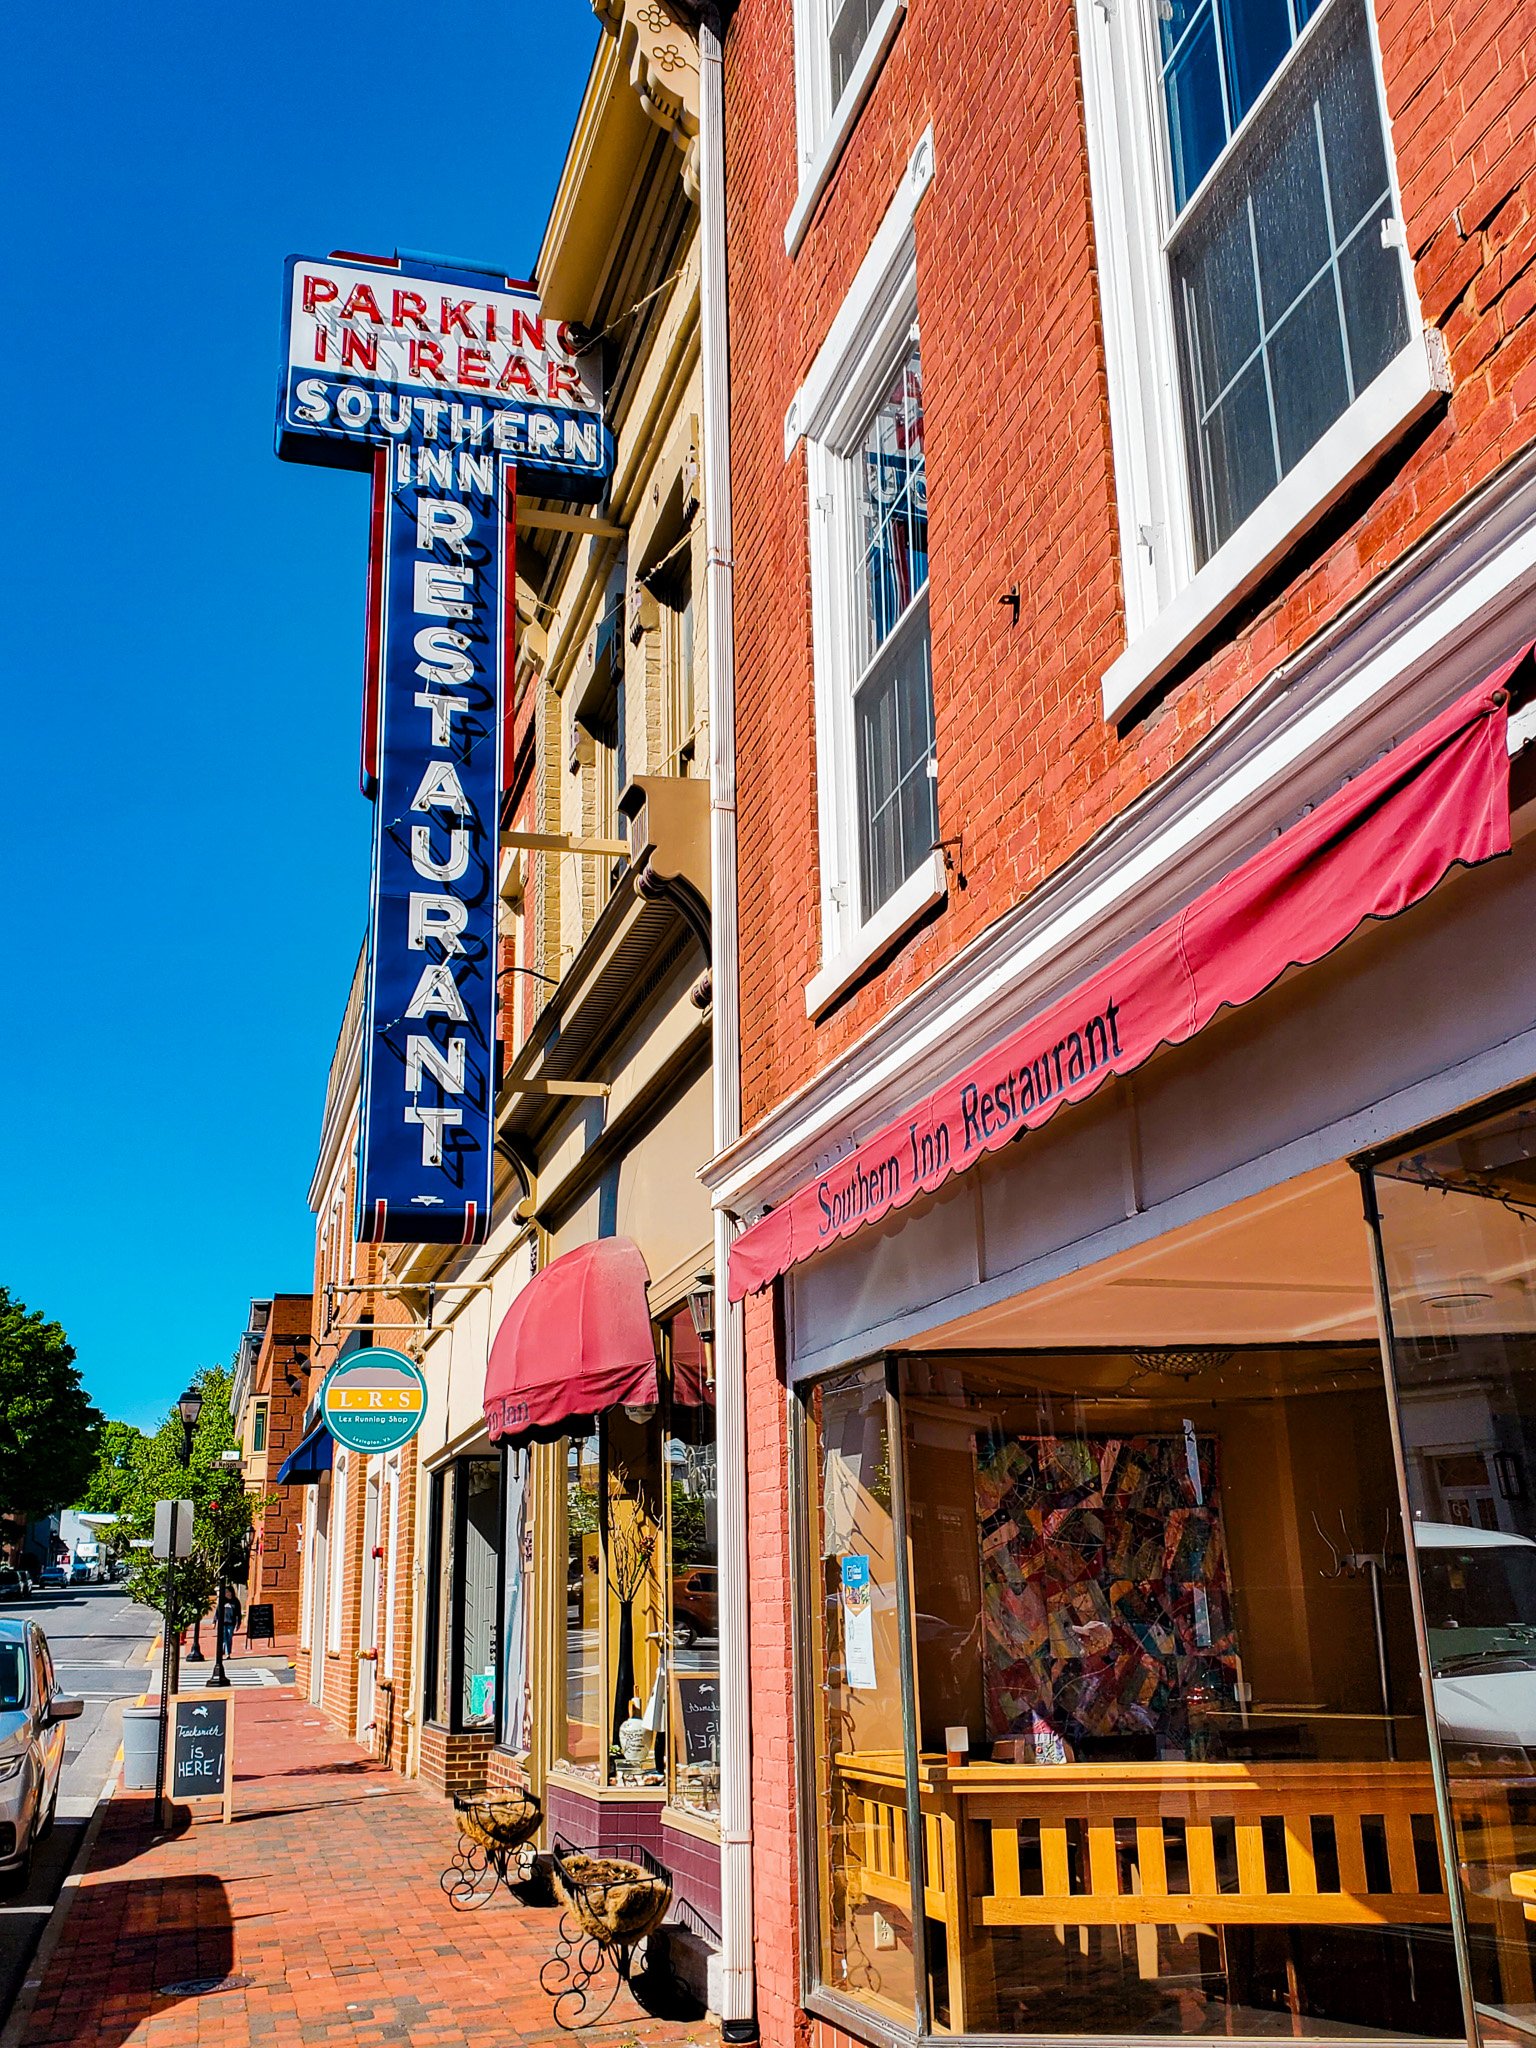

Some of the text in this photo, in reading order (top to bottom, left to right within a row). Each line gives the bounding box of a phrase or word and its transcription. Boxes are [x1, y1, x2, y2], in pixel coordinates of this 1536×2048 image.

[314, 323, 587, 401] IN REAR
[295, 379, 597, 463] SOUTHERN
[397, 443, 494, 495] INN
[403, 496, 475, 1167] RESTAURANT
[818, 995, 1123, 1237] Southern Inn Restaurant
[355, 1416, 386, 1424] Running
[388, 1416, 408, 1424] Shop
